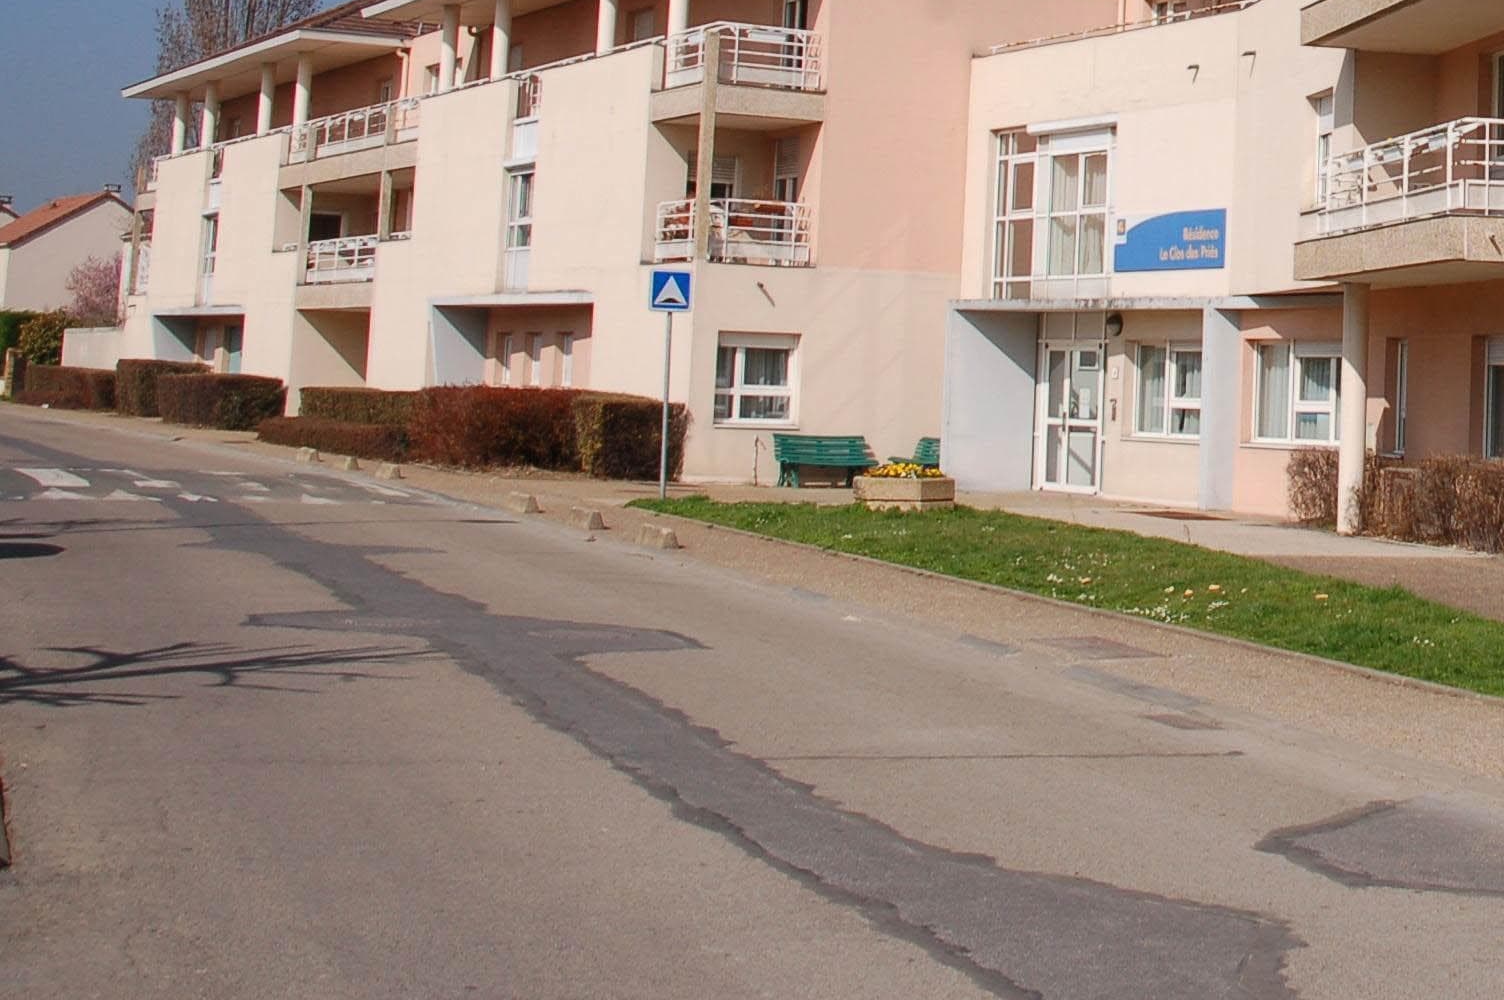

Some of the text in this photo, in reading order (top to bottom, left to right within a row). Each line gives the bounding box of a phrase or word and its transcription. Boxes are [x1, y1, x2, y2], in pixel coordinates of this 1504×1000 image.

[1159, 248, 1169, 260] Le
[1169, 245, 1185, 260] Clos
[1186, 244, 1199, 259] des
